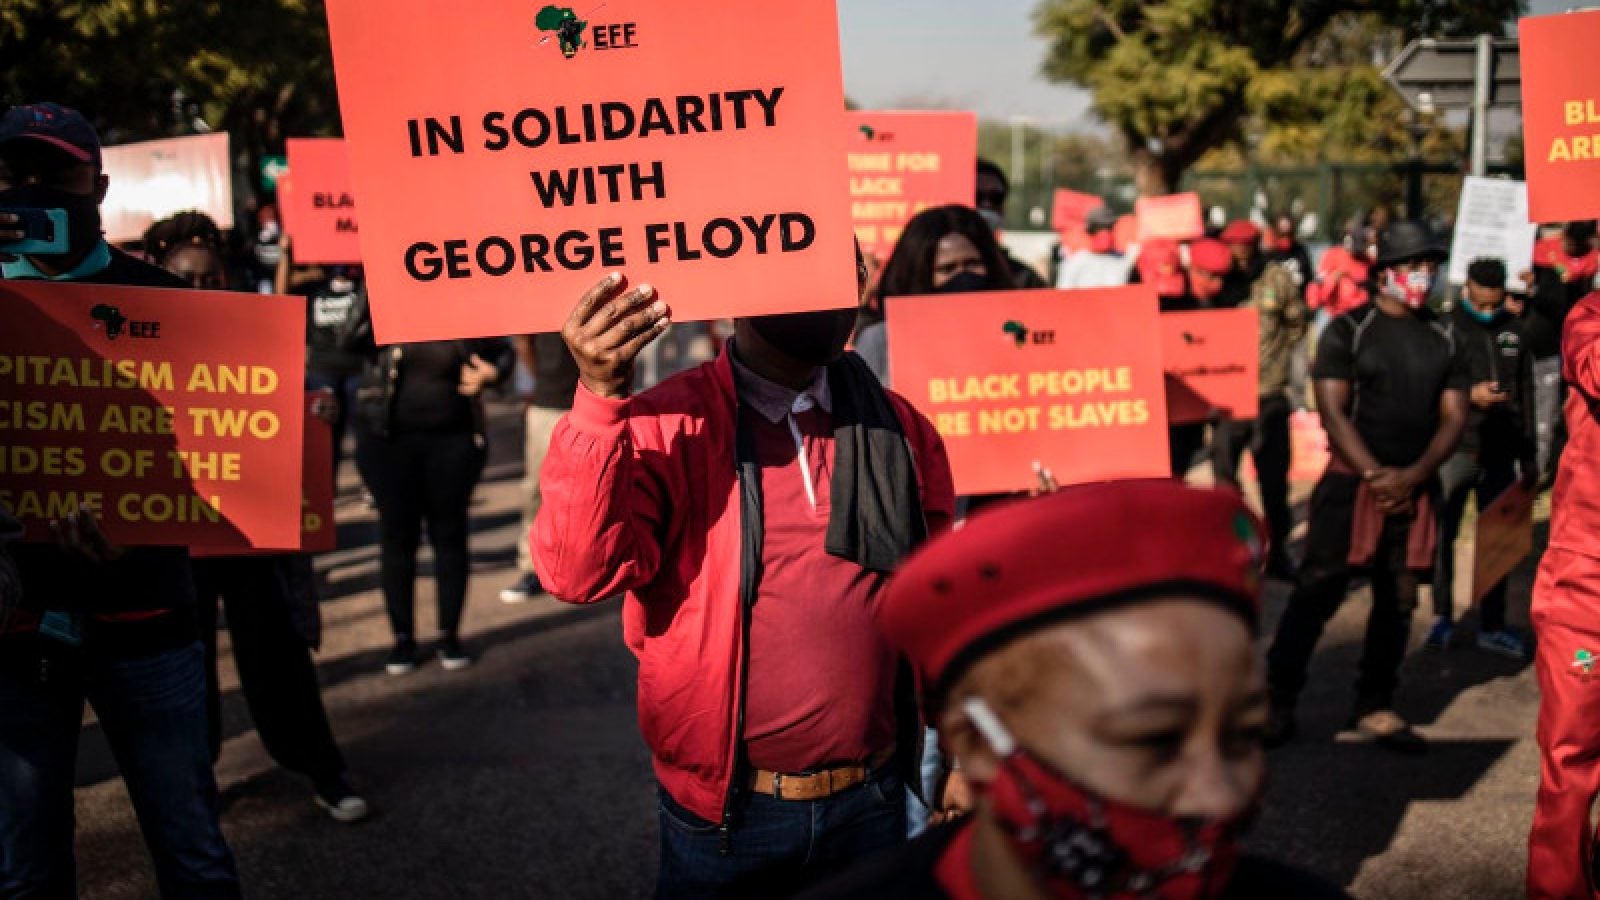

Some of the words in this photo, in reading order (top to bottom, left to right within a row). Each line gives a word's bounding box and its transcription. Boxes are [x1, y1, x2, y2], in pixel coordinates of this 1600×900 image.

[593, 23, 638, 50] EFF
[407, 115, 464, 158] IN
[483, 87, 785, 151] SOLIDARITY
[530, 161, 666, 209] WITH
[404, 227, 626, 282] GEORGE
[645, 211, 816, 264] FLOYD
[129, 321, 160, 338] EFF
[186, 363, 278, 395] AND
[929, 373, 1020, 403] BLACK
[1028, 366, 1132, 397] PEOPLE
[100, 405, 175, 434] ARE
[188, 408, 280, 439] TWO
[979, 407, 1041, 434] NOT
[1049, 399, 1149, 429] SLAVES
[101, 448, 154, 478] OF
[167, 451, 241, 481] THE
[117, 494, 220, 523] COIN
